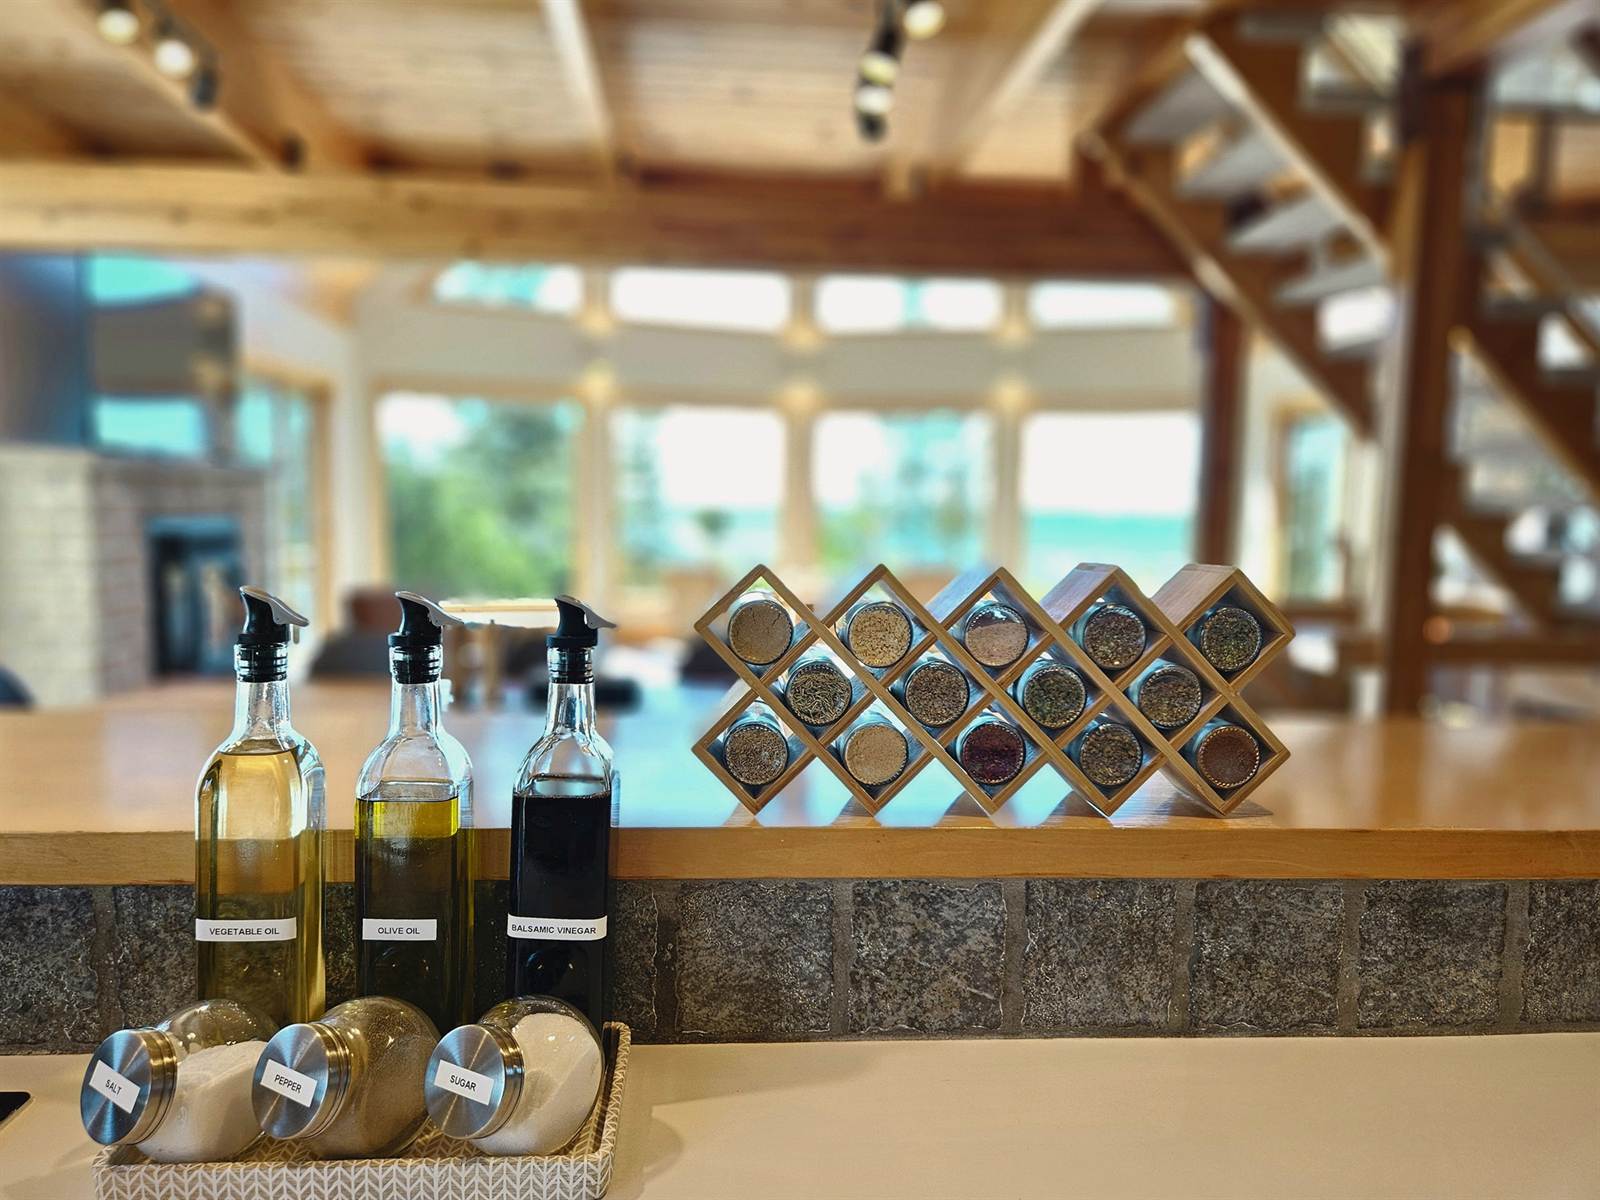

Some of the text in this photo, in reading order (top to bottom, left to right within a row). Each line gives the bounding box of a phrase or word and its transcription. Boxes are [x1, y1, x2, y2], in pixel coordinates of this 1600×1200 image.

[264, 927, 279, 935] OIL
[377, 927, 420, 935] OLIVE OIL
[511, 925, 596, 935] BALSAMIC VINEGAR
[105, 1079, 122, 1095] SALT
[274, 1074, 302, 1093] PEPPER
[449, 1075, 477, 1092] SUGAR
